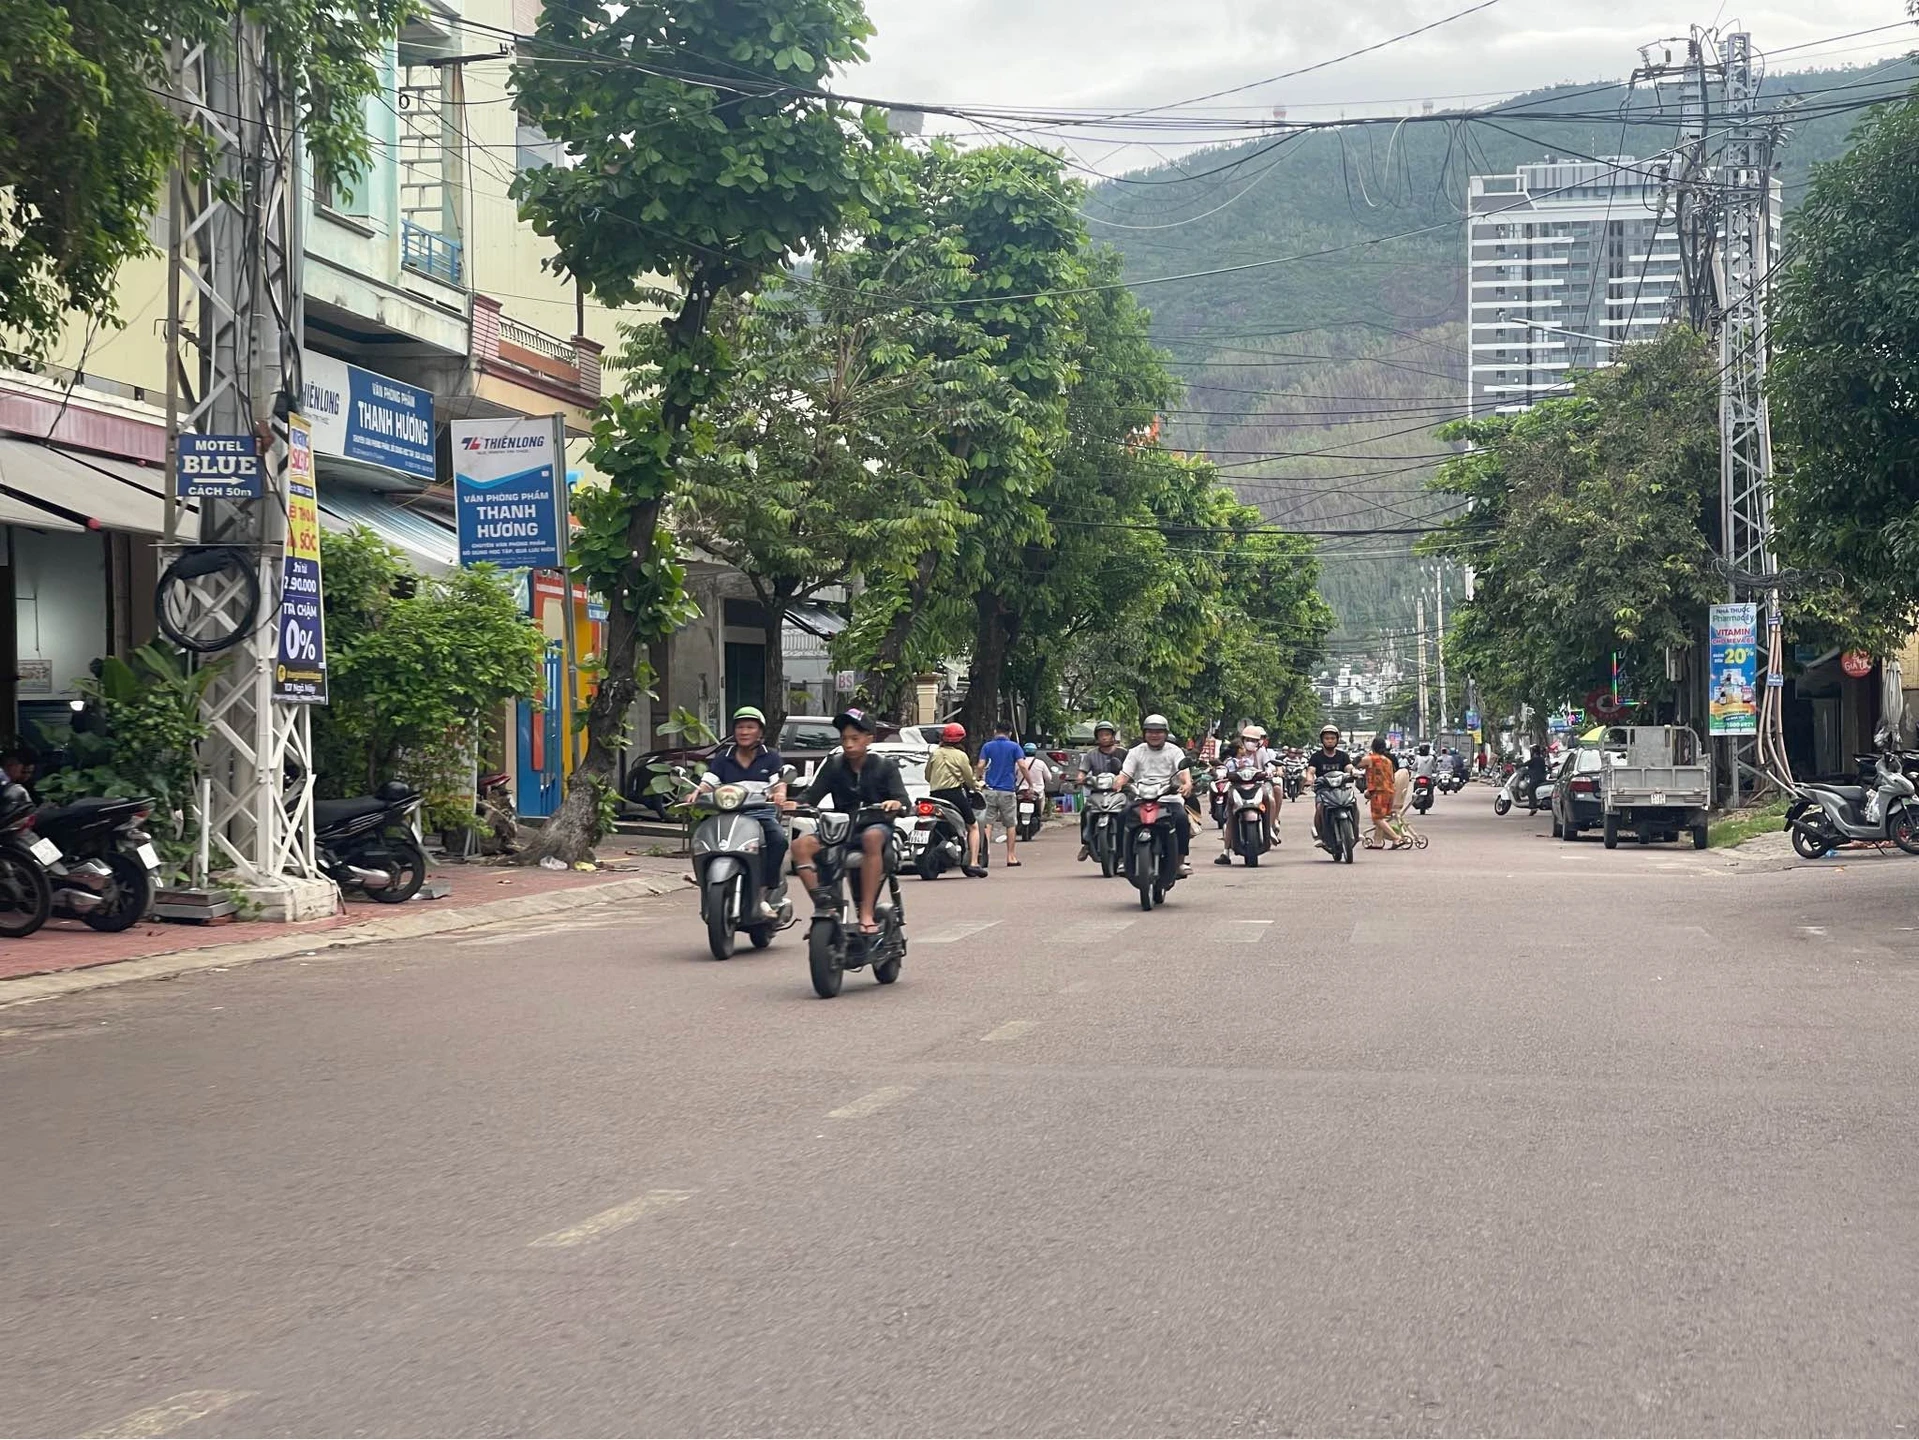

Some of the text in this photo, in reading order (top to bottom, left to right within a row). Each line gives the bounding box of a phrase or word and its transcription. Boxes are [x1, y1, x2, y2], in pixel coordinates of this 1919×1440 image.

[358, 400, 393, 437] THANH
[395, 411, 429, 447] HƯƠNG
[195, 440, 245, 452] MOTEL
[484, 435, 545, 450] THIÊNLONG
[182, 455, 258, 475] BLUE
[188, 484, 252, 496] CÁCH 50m
[463, 490, 549, 503] VĂN PHÒNG PHẨM
[476, 504, 537, 520] THANH
[477, 521, 539, 539] HƯƠNG
[297, 601, 318, 620] CHẬM
[285, 619, 317, 661] 0%
[1716, 628, 1751, 637] VITAMIN
[1724, 647, 1755, 665] 20%
[839, 674, 853, 689] BS
